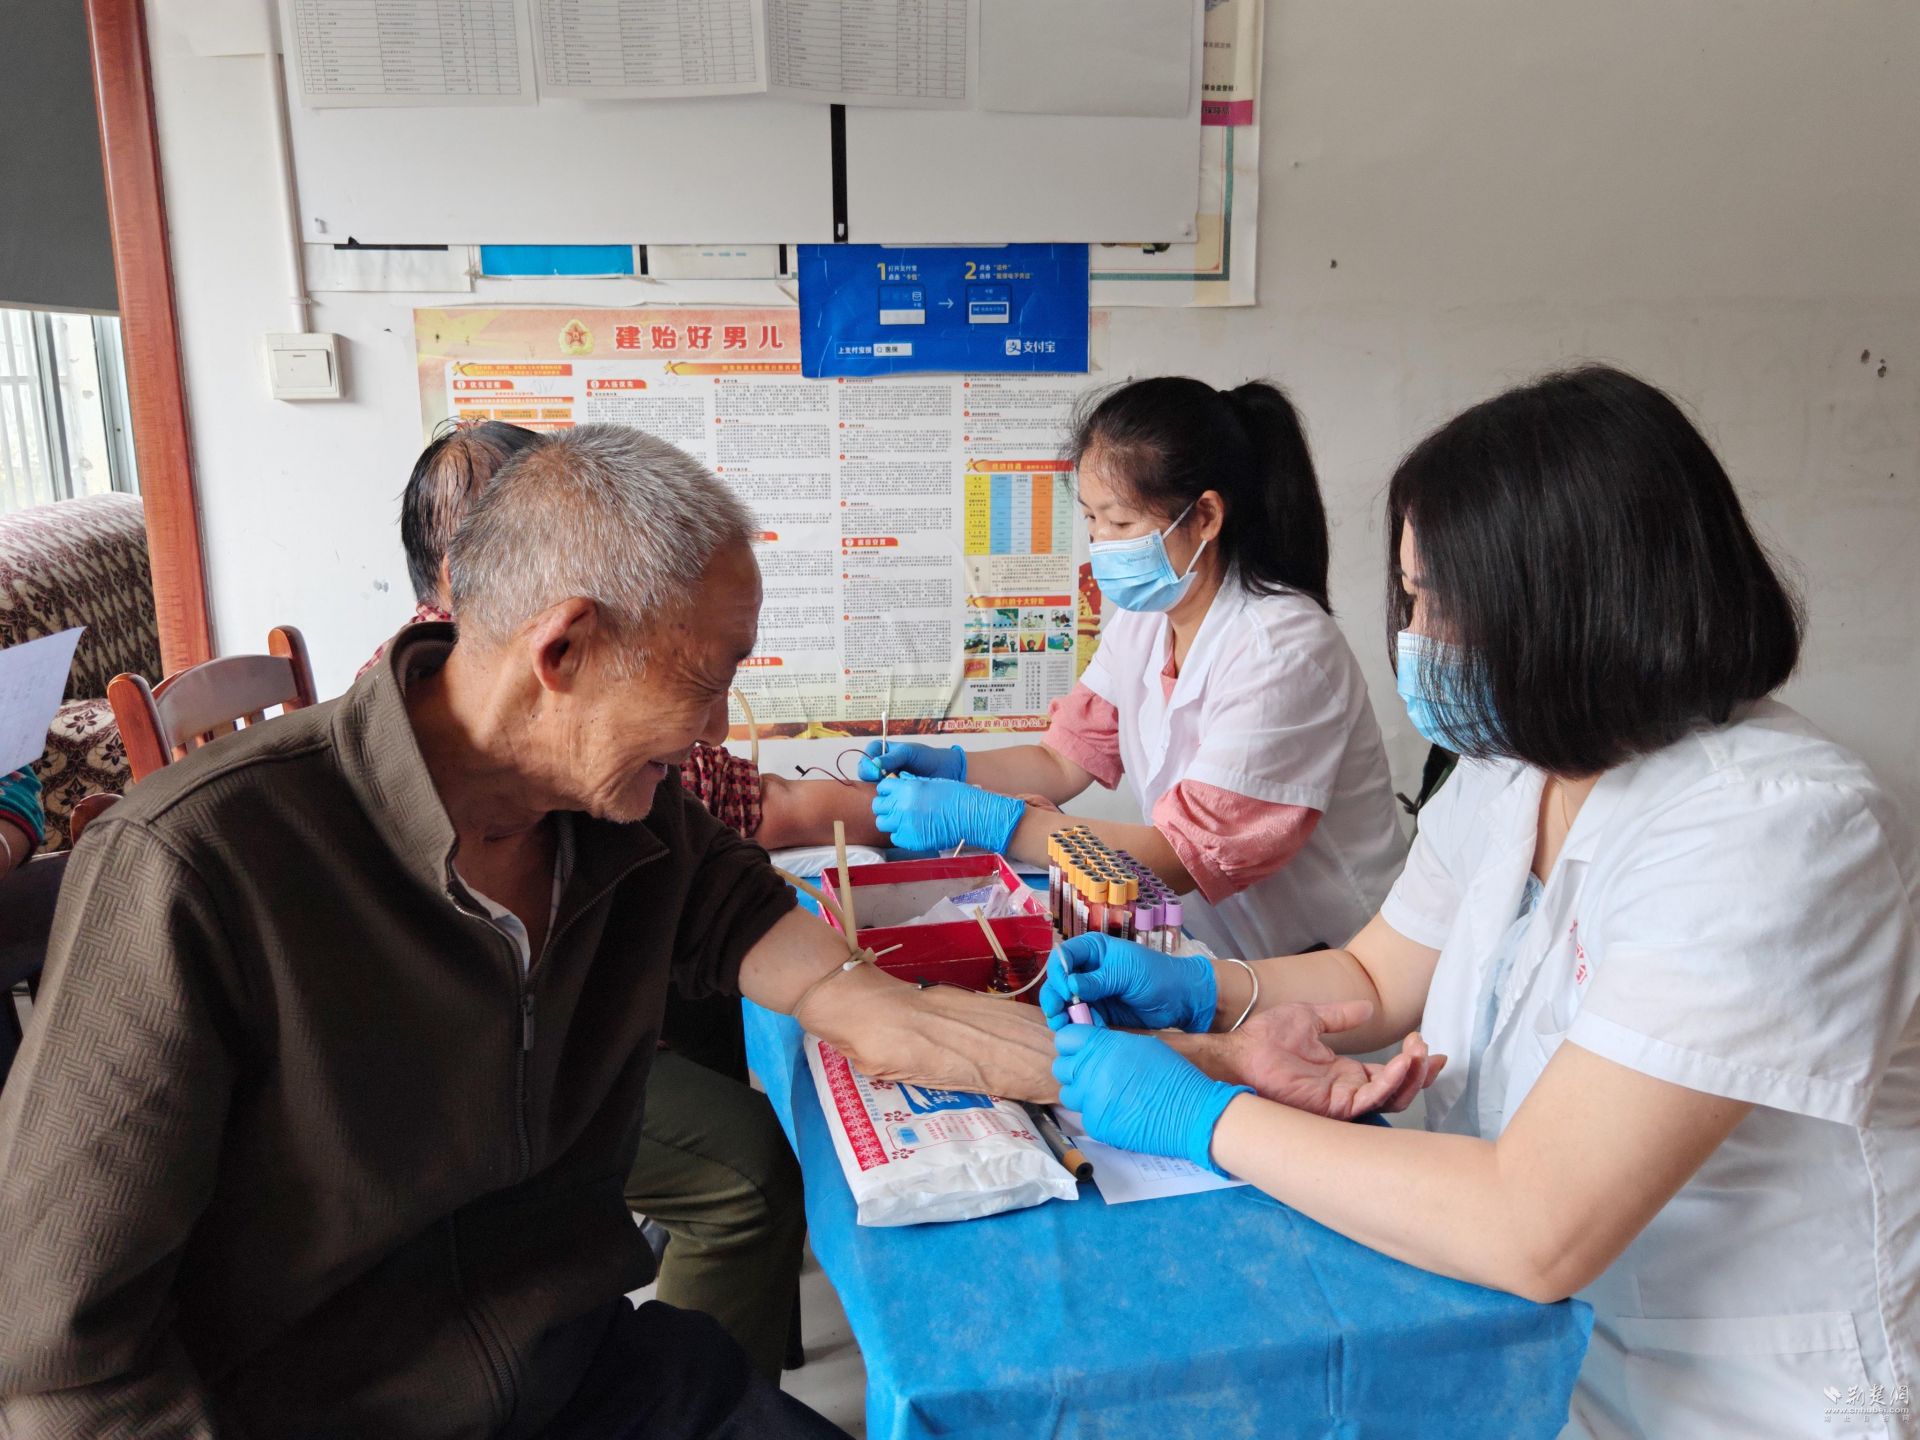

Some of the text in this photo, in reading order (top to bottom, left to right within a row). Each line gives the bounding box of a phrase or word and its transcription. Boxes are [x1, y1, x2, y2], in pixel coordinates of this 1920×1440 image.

[877, 262, 886, 281] 1
[965, 261, 977, 280] 2
[615, 325, 785, 350] 建始好男儿
[1022, 340, 1056, 354] 支付宝
